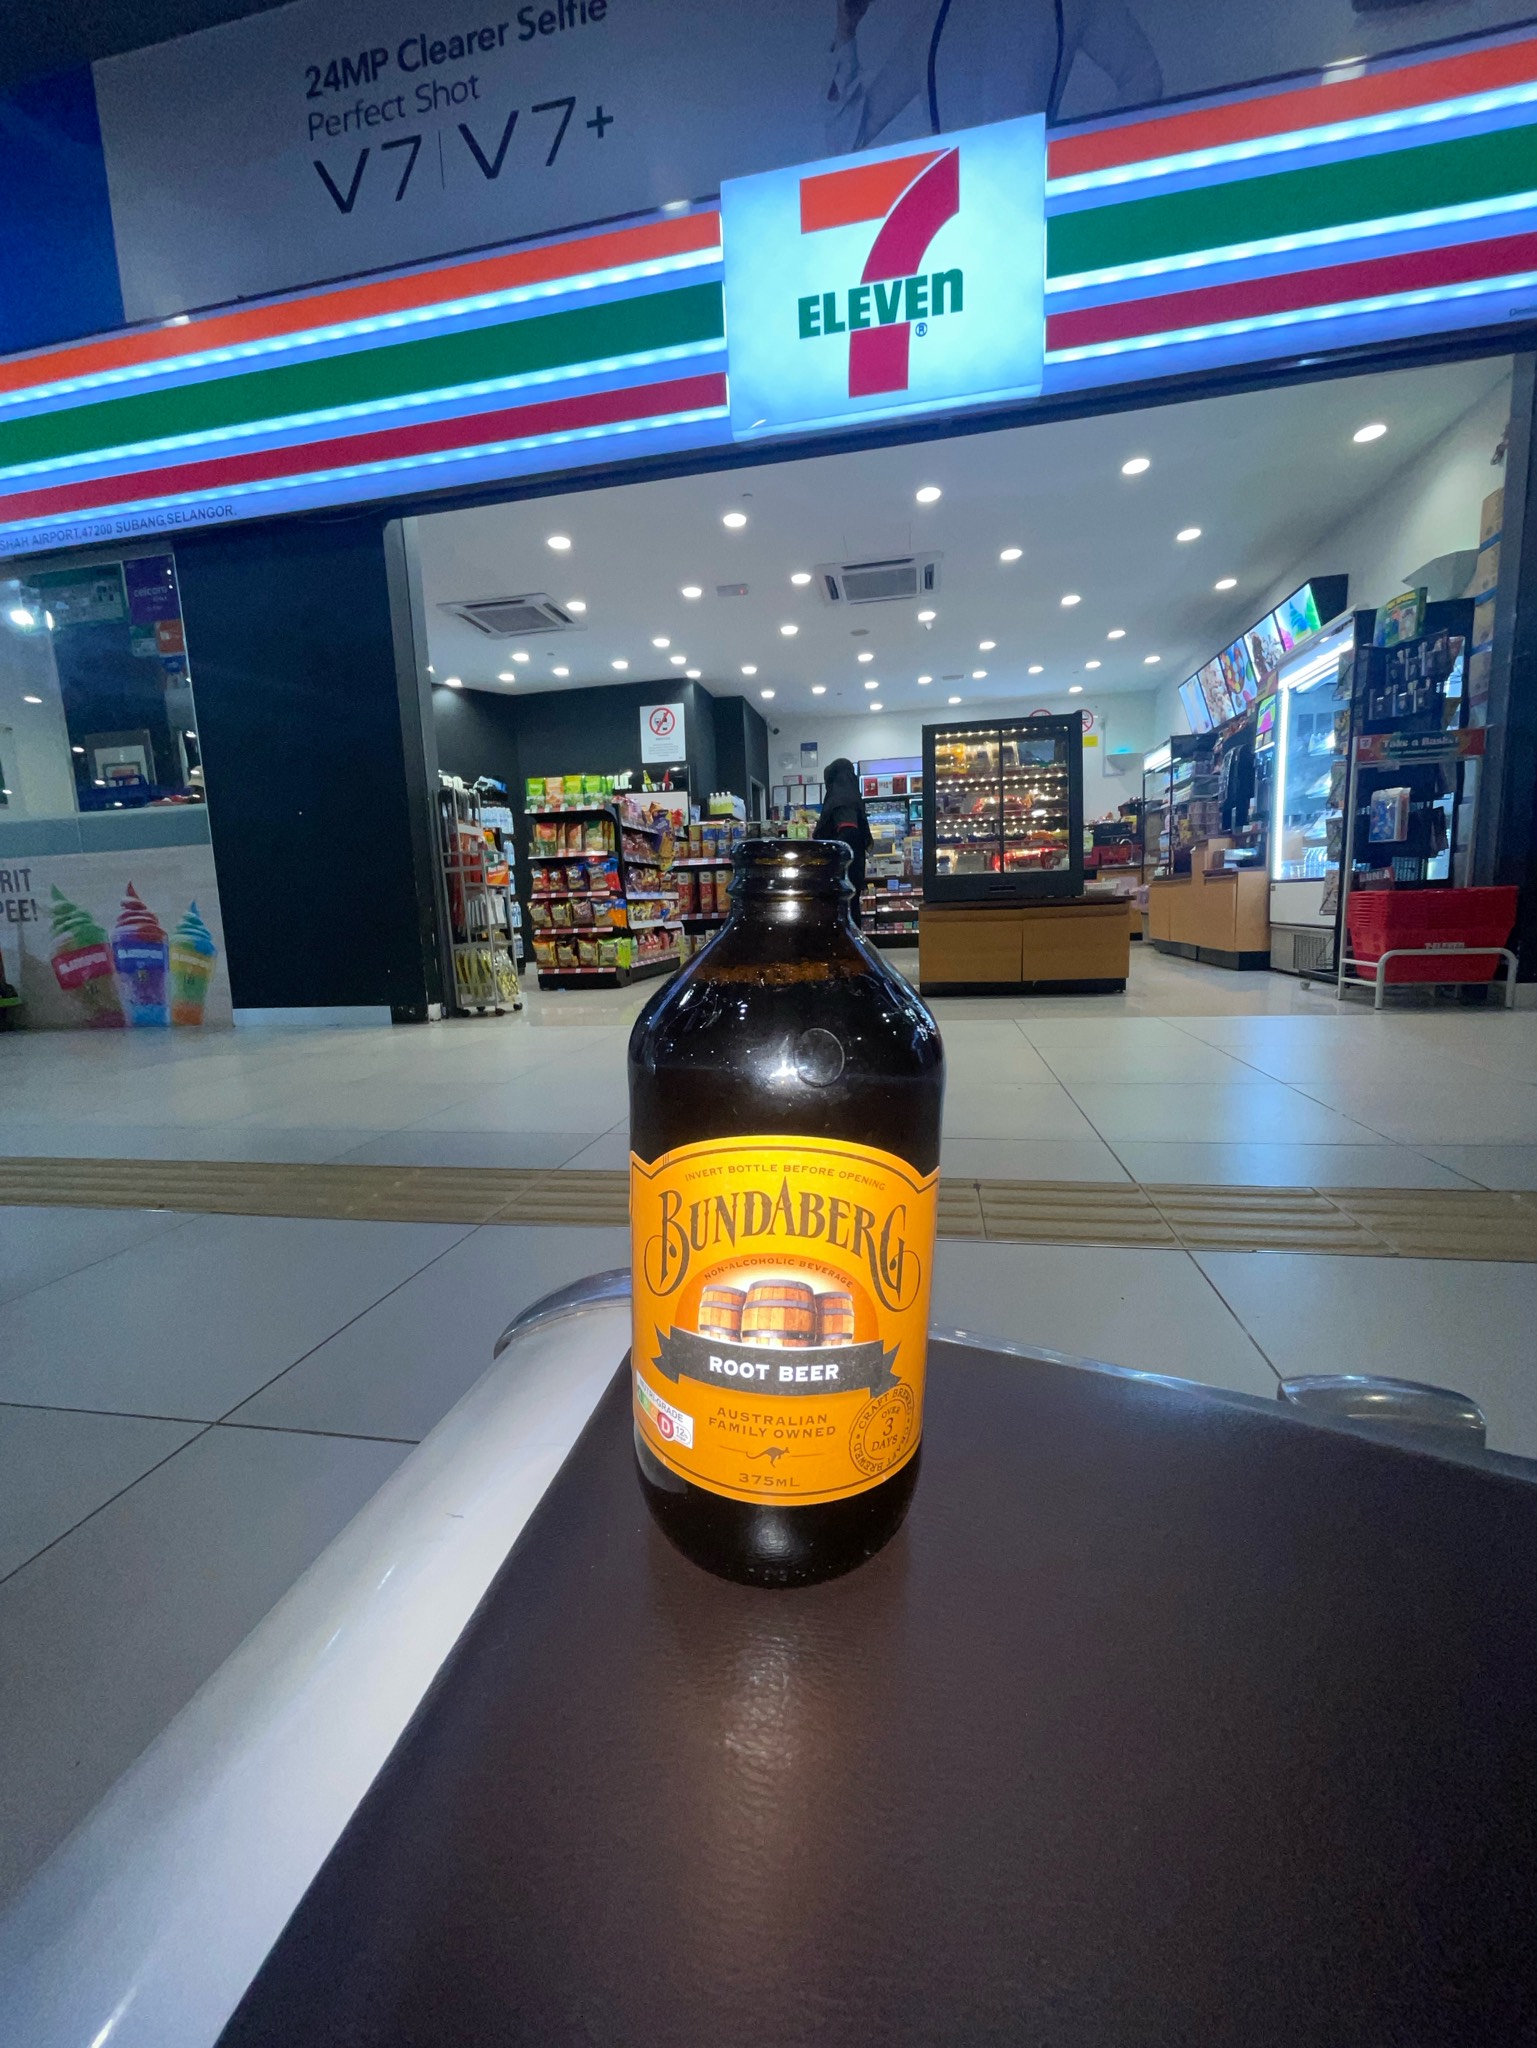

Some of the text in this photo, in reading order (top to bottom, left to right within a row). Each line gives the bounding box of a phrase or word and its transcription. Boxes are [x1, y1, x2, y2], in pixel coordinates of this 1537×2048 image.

[304, 47, 389, 99] 24MP
[397, 22, 509, 73] Clearer
[307, 74, 481, 142] Perfect Shot
[312, 133, 422, 214] V7
[684, 1164, 886, 1191] INVERT BOTTLE BEFORE OPENING
[644, 1175, 921, 1312] BUNDABERG
[704, 1257, 853, 1288] NON-ALCOHOLIC BEVERAGE
[709, 1355, 839, 1383] ROOT BEER
[717, 1406, 828, 1426] AUSTRALIAN
[858, 1392, 890, 1430] CRAFT
[881, 1406, 901, 1419] OVER
[708, 1416, 768, 1438] FAMILY
[773, 1426, 837, 1439] OWNED
[882, 1416, 894, 1437] 3
[870, 1434, 898, 1452] DAYS
